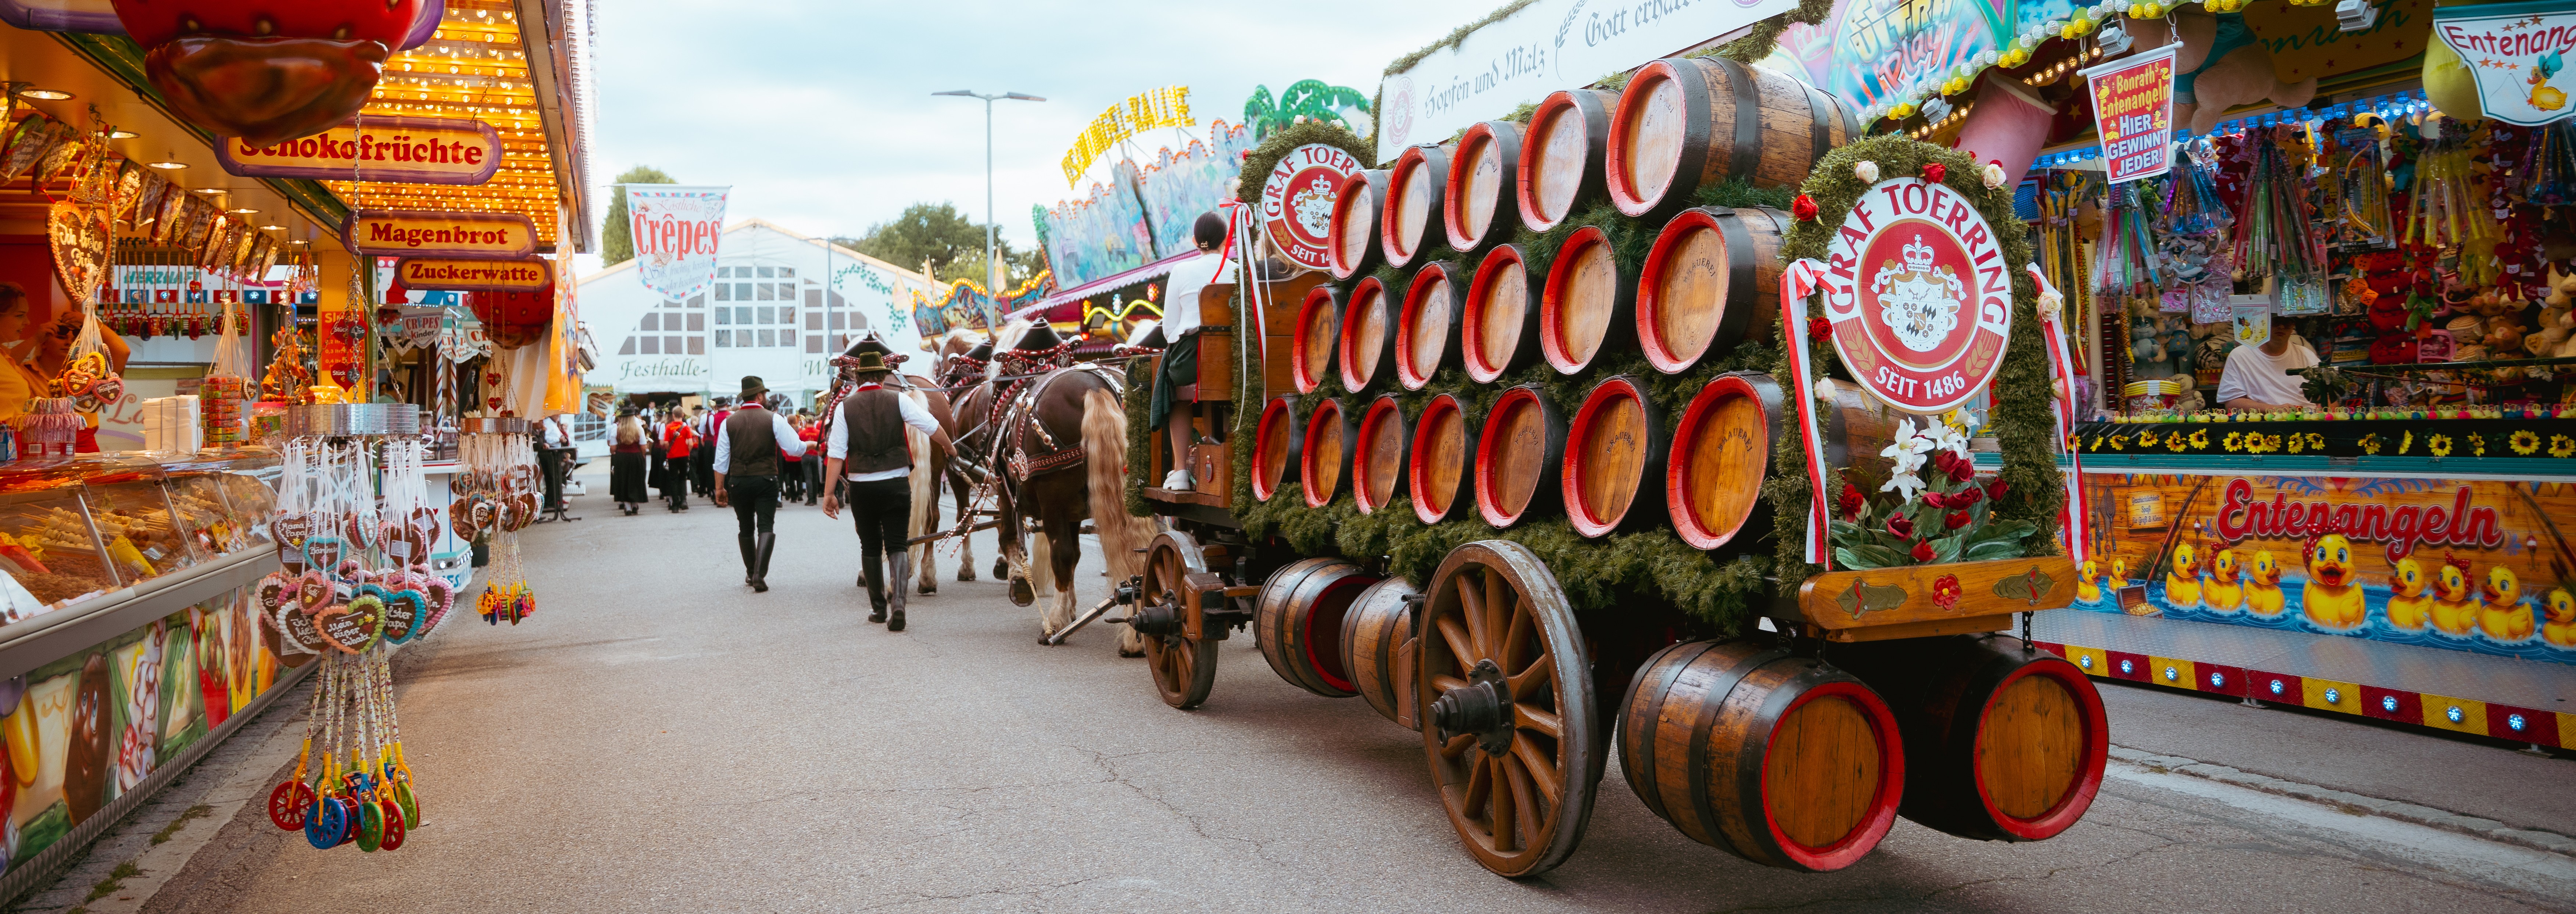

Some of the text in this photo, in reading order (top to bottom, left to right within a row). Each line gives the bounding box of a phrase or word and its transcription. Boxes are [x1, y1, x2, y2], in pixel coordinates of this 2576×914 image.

[1425, 75, 1469, 118] Hopfen
[1474, 58, 1499, 94] und
[1505, 40, 1545, 80] Malz
[1585, 8, 1627, 47] Gott
[1878, 22, 1949, 94] Play
[1388, 79, 1414, 125] GRAF TOERRING
[2100, 79, 2169, 119] Entenangeln
[2119, 114, 2152, 137] HIER
[2107, 129, 2167, 160] GEWINNT
[1477, 157, 1497, 176] BRAUEREI
[2117, 148, 2162, 177] JEDER!
[1265, 156, 1295, 217] GRAF
[651, 199, 702, 214] Köstliche
[370, 223, 508, 247] Magenbrot
[634, 214, 720, 261] Crêpes
[1291, 244, 1317, 262] SEIT
[1828, 184, 2007, 326] GRAF TOERRING
[410, 264, 538, 281] Zuckerwatte
[411, 330, 435, 339] kinder
[620, 358, 708, 380] Festhalle-
[1875, 366, 1965, 399] SEIT 1486
[1515, 426, 1539, 447] BRAUEREI
[1606, 431, 1636, 454] BRAUEREI
[1717, 428, 1753, 452] BRAUEREI
[282, 522, 305, 531] Mama
[2217, 477, 2504, 565] Entenangeln
[309, 546, 339, 555] Bärchen
[304, 585, 320, 598] Mutti
[328, 619, 354, 632] Mein
[333, 627, 360, 639] süßer
[341, 632, 371, 647] Schatz
